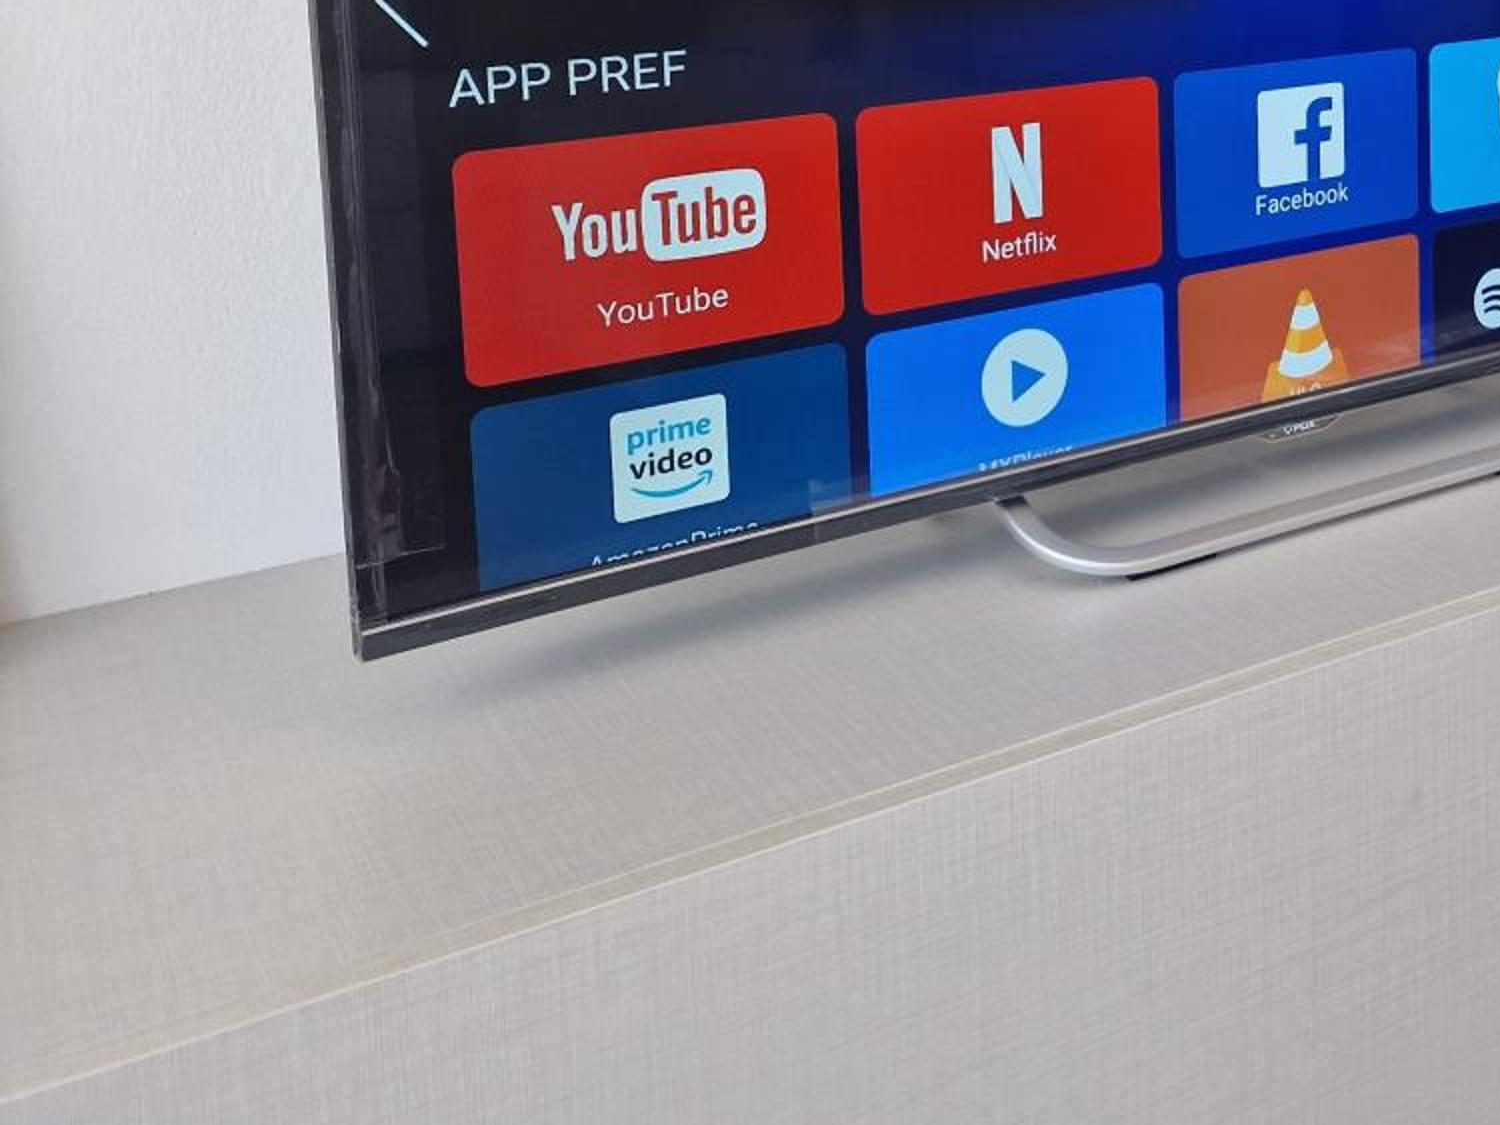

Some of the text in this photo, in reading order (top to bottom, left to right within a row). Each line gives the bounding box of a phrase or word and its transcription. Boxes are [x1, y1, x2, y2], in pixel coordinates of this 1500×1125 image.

[449, 49, 688, 109] APP PREF
[1255, 182, 1350, 216] Facebook
[551, 185, 758, 263] YouTube
[982, 231, 1057, 264] Netflix
[597, 286, 730, 328] YouTube
[627, 415, 712, 456] prime
[629, 446, 713, 480] video
